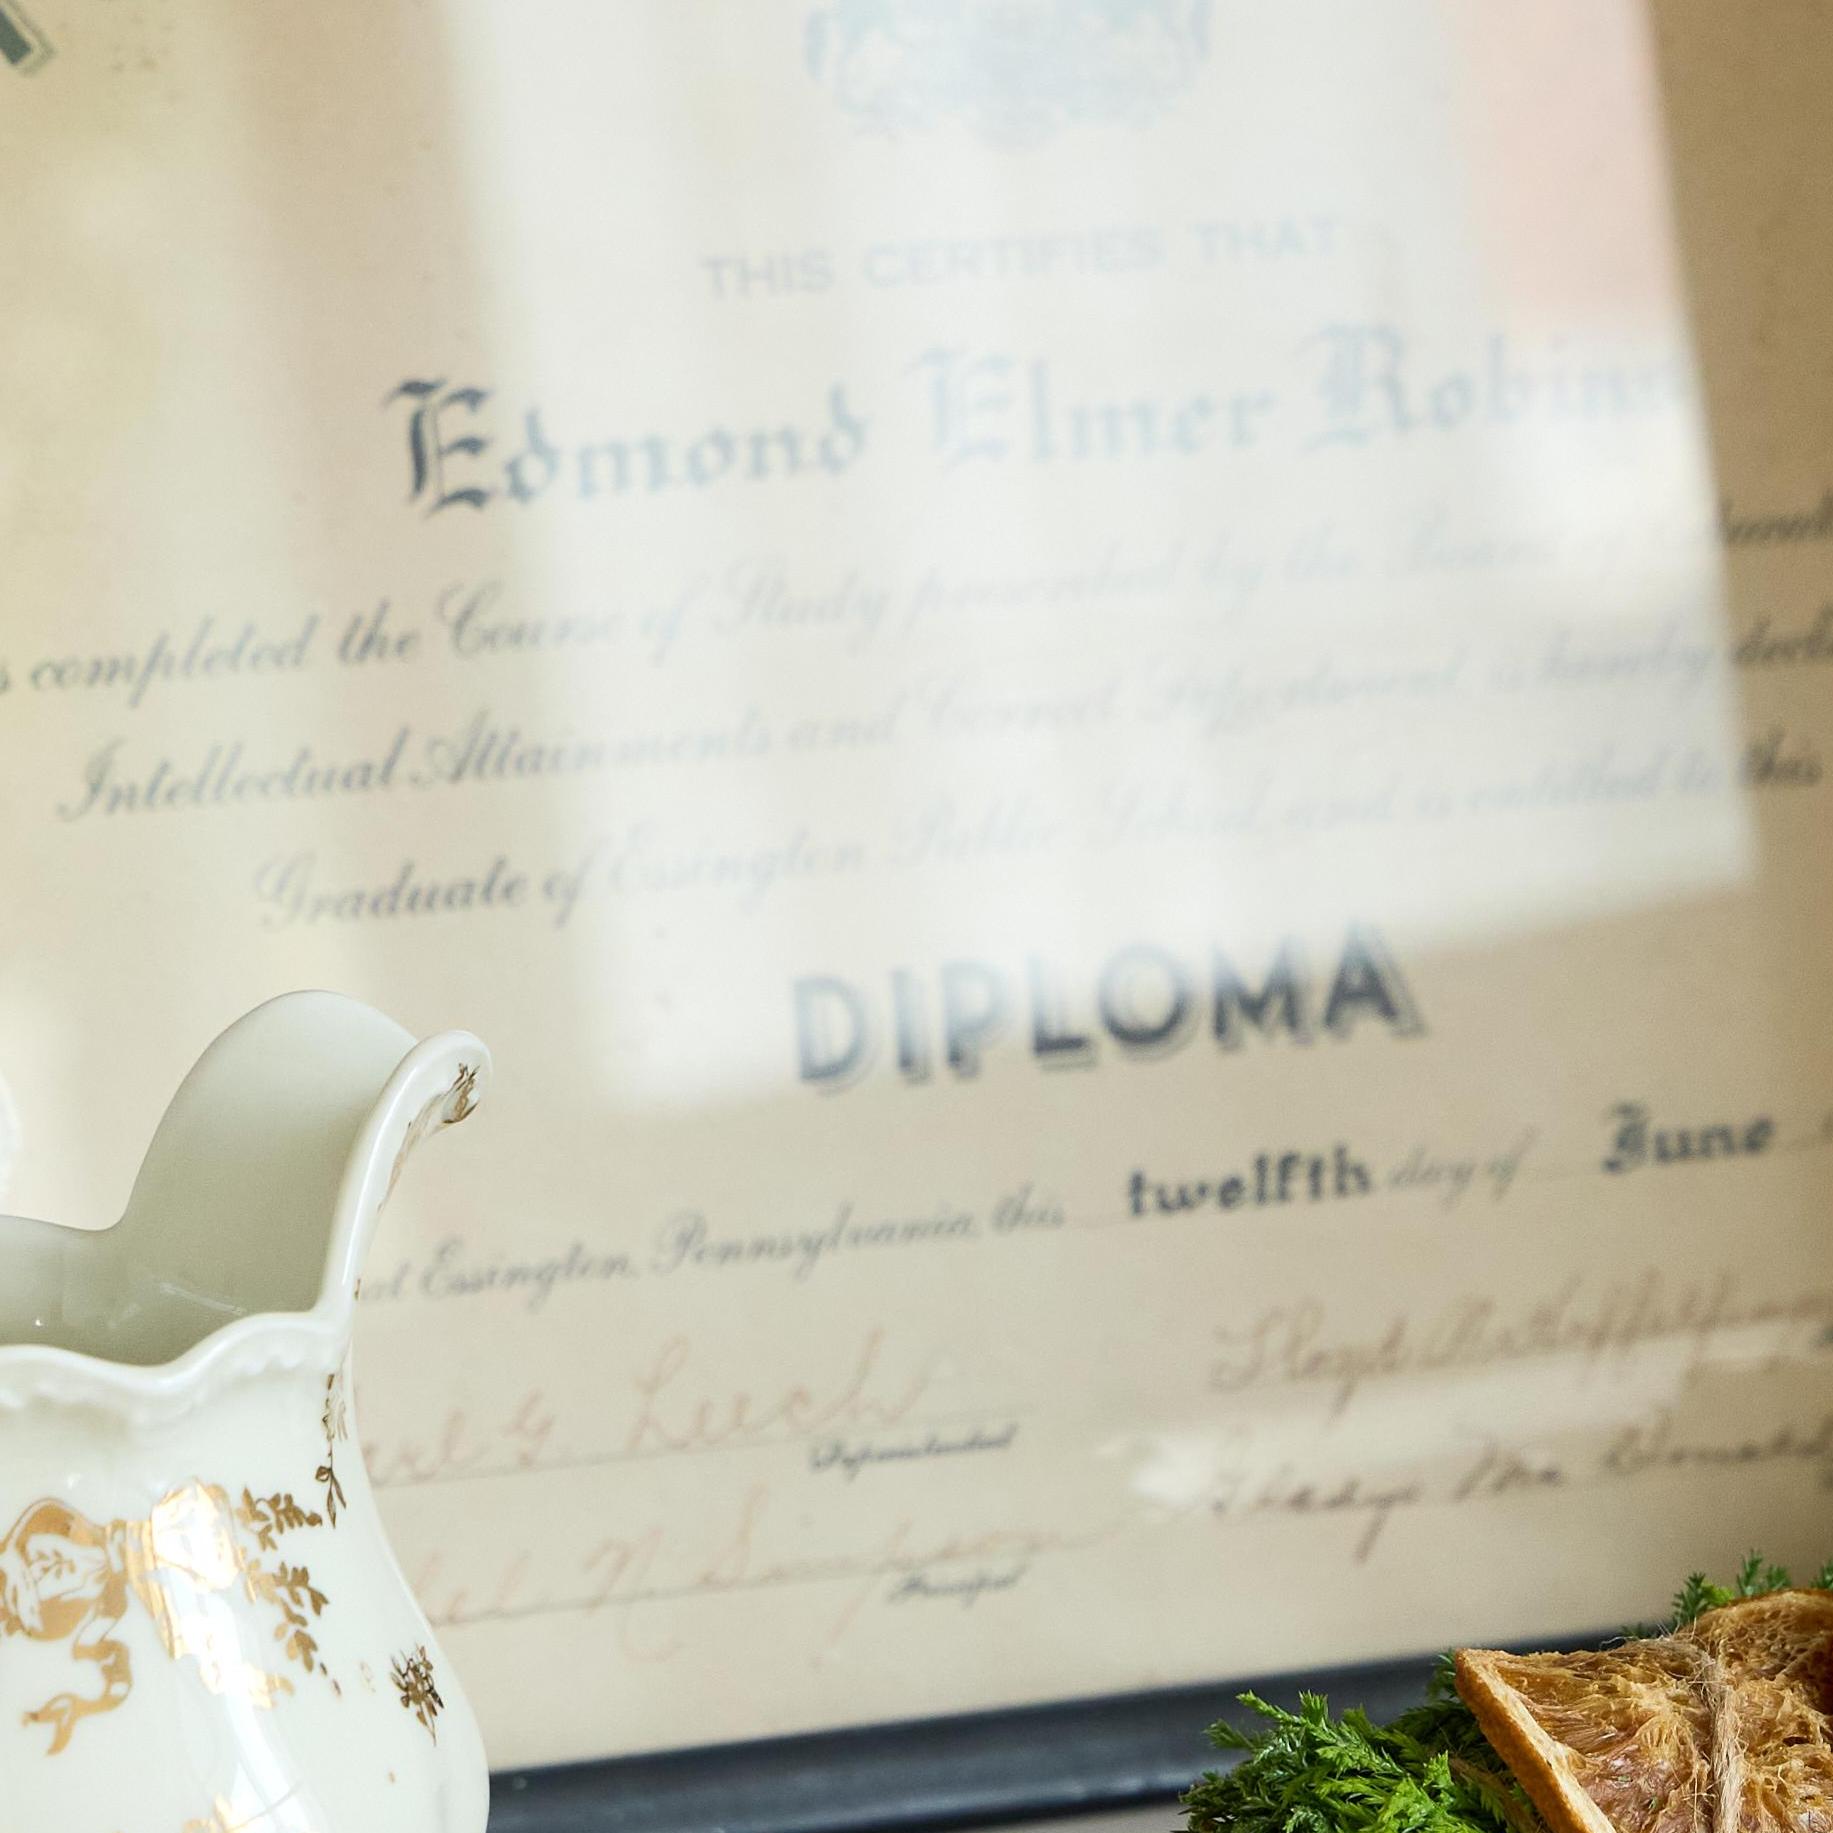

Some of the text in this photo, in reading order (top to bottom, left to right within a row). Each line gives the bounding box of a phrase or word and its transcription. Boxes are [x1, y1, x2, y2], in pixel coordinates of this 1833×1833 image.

[700, 211, 1342, 300] THIS CERTIFIES THAT
[383, 378, 872, 522] Edmond
[903, 338, 1282, 476] Elmer
[30, 612, 322, 708] completed
[335, 597, 424, 668] the
[433, 578, 624, 666] Course
[55, 722, 410, 824] Intellectual
[410, 705, 773, 793] Attainments
[785, 687, 907, 754] and
[252, 848, 530, 936] Graduate
[610, 819, 867, 915] Essington
[792, 921, 1432, 1096] DIPLOMA
[990, 1182, 1066, 1234] this
[1126, 1141, 1374, 1219] twelfth
[1388, 1140, 1474, 1213] day
[1600, 1099, 1777, 1176] June
